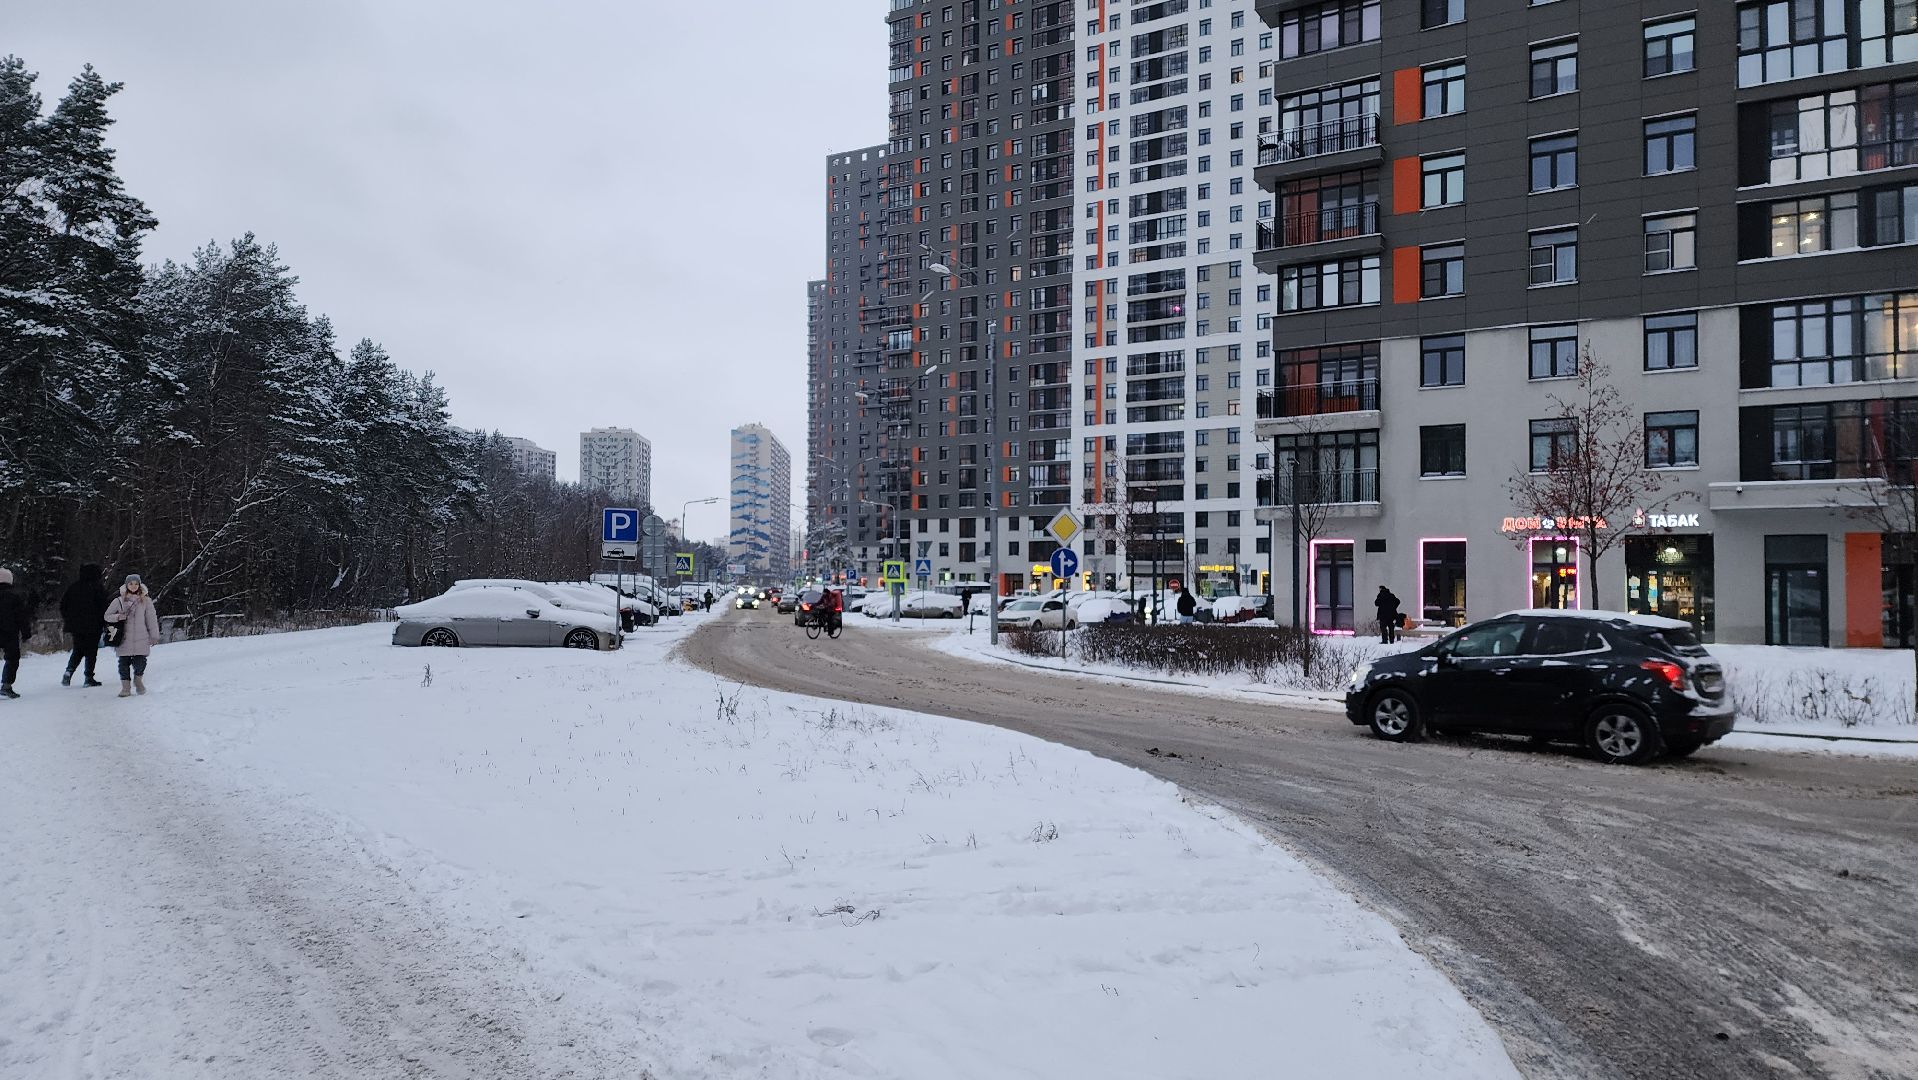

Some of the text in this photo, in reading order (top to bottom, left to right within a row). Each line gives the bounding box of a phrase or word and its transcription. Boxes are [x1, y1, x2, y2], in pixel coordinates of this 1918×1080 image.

[612, 513, 630, 538] P
[1502, 515, 1541, 532] ДОМ
[1648, 513, 1700, 528] ТАБАК
